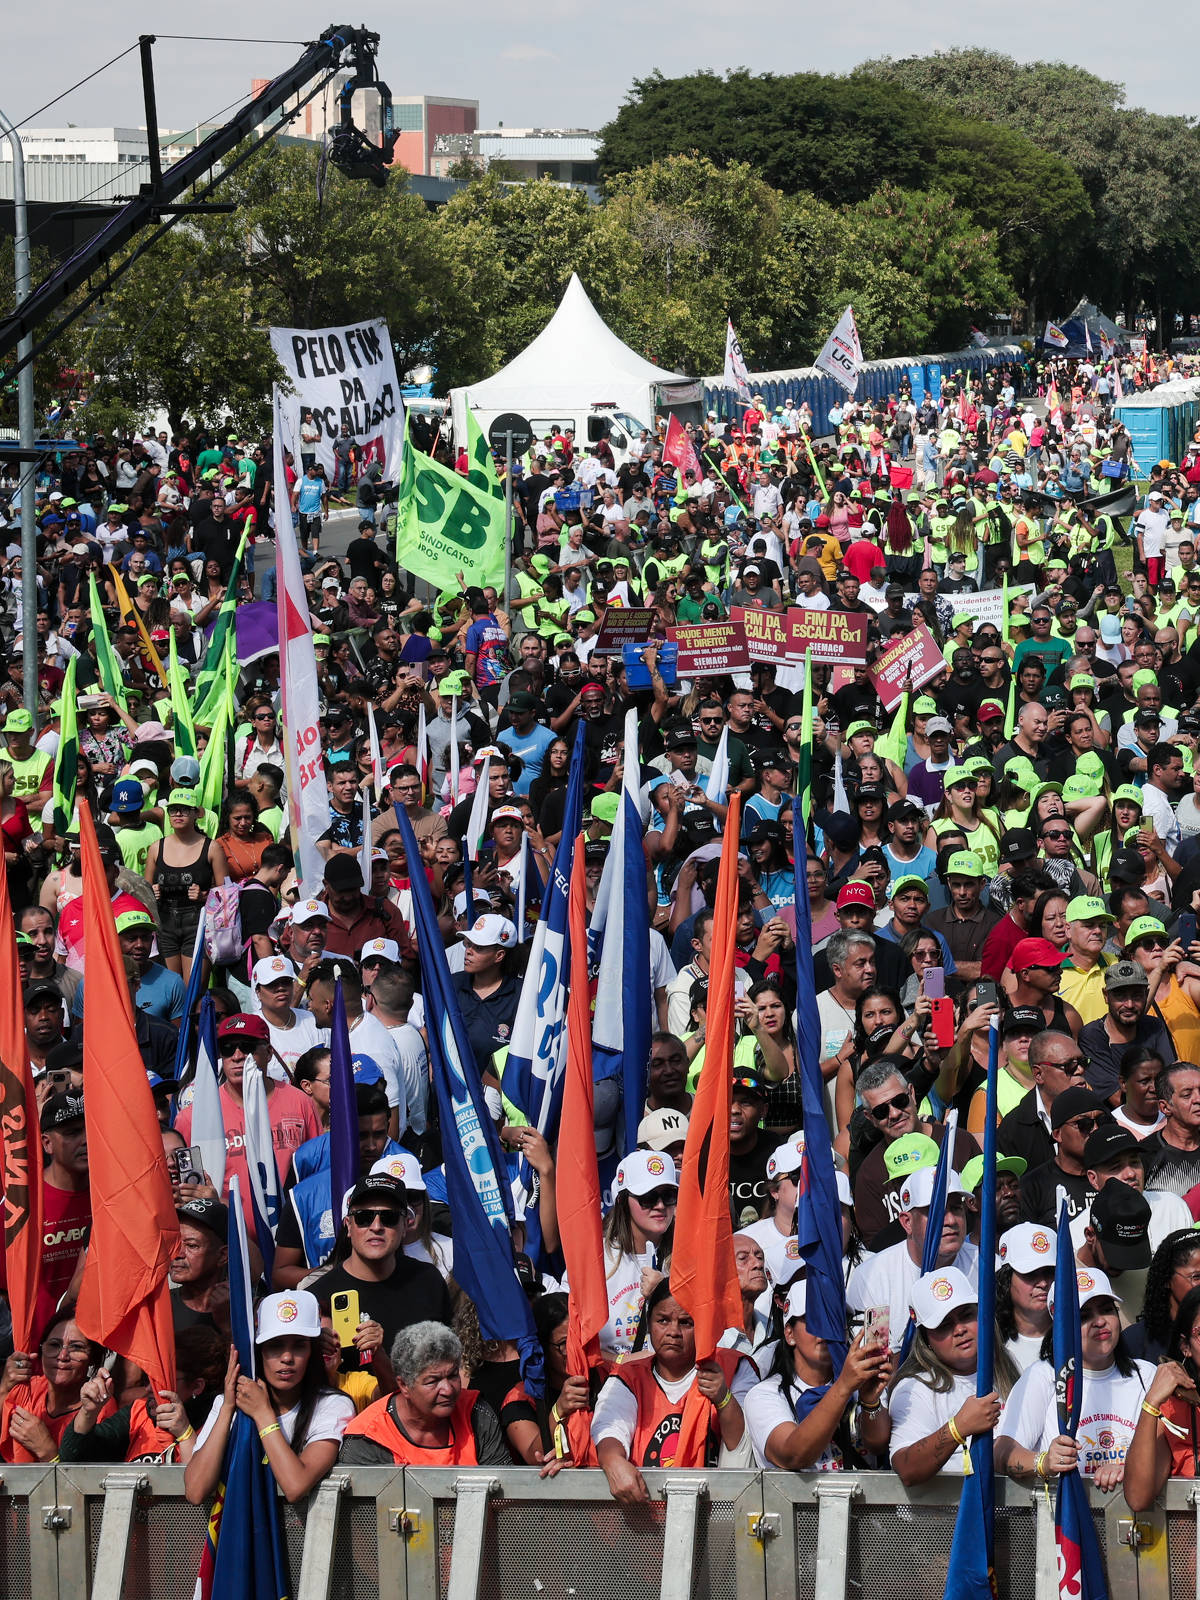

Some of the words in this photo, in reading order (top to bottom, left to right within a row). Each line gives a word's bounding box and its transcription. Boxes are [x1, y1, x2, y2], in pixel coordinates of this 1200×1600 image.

[291, 335, 346, 379] PELO
[340, 377, 367, 406] DA
[419, 530, 475, 568] SINDICATOS
[953, 596, 991, 606] acidentes
[744, 610, 763, 625] FIM
[766, 614, 781, 628] DA
[804, 611, 828, 626] FIM
[831, 613, 848, 628] DA
[675, 627, 702, 641] SAÚDE
[703, 626, 736, 637] MENTAL
[792, 623, 837, 641] ESCALA
[841, 628, 861, 643] 6x1
[694, 637, 728, 648] DIREITO!
[748, 640, 778, 653] SIEMACO
[809, 642, 844, 653] SIEMACO
[693, 655, 728, 667] SIEMACO
[871, 637, 914, 675] VALORIZAÇÃO
[884, 661, 900, 677] NOSSO
[899, 642, 925, 664] TRABALHO
[886, 668, 902, 684] MOVE
[899, 664, 906, 673] O
[1087, 900, 1100, 908] CSB
[661, 1116, 680, 1130] NY
[893, 1153, 910, 1166] CSB
[610, 1284, 633, 1306] CAMPANHA
[633, 1281, 640, 1289] DE
[615, 1318, 623, 1326] A
[616, 1327, 621, 1337] É
[1094, 1413, 1101, 1421] DE
[655, 1417, 682, 1443] FOR
